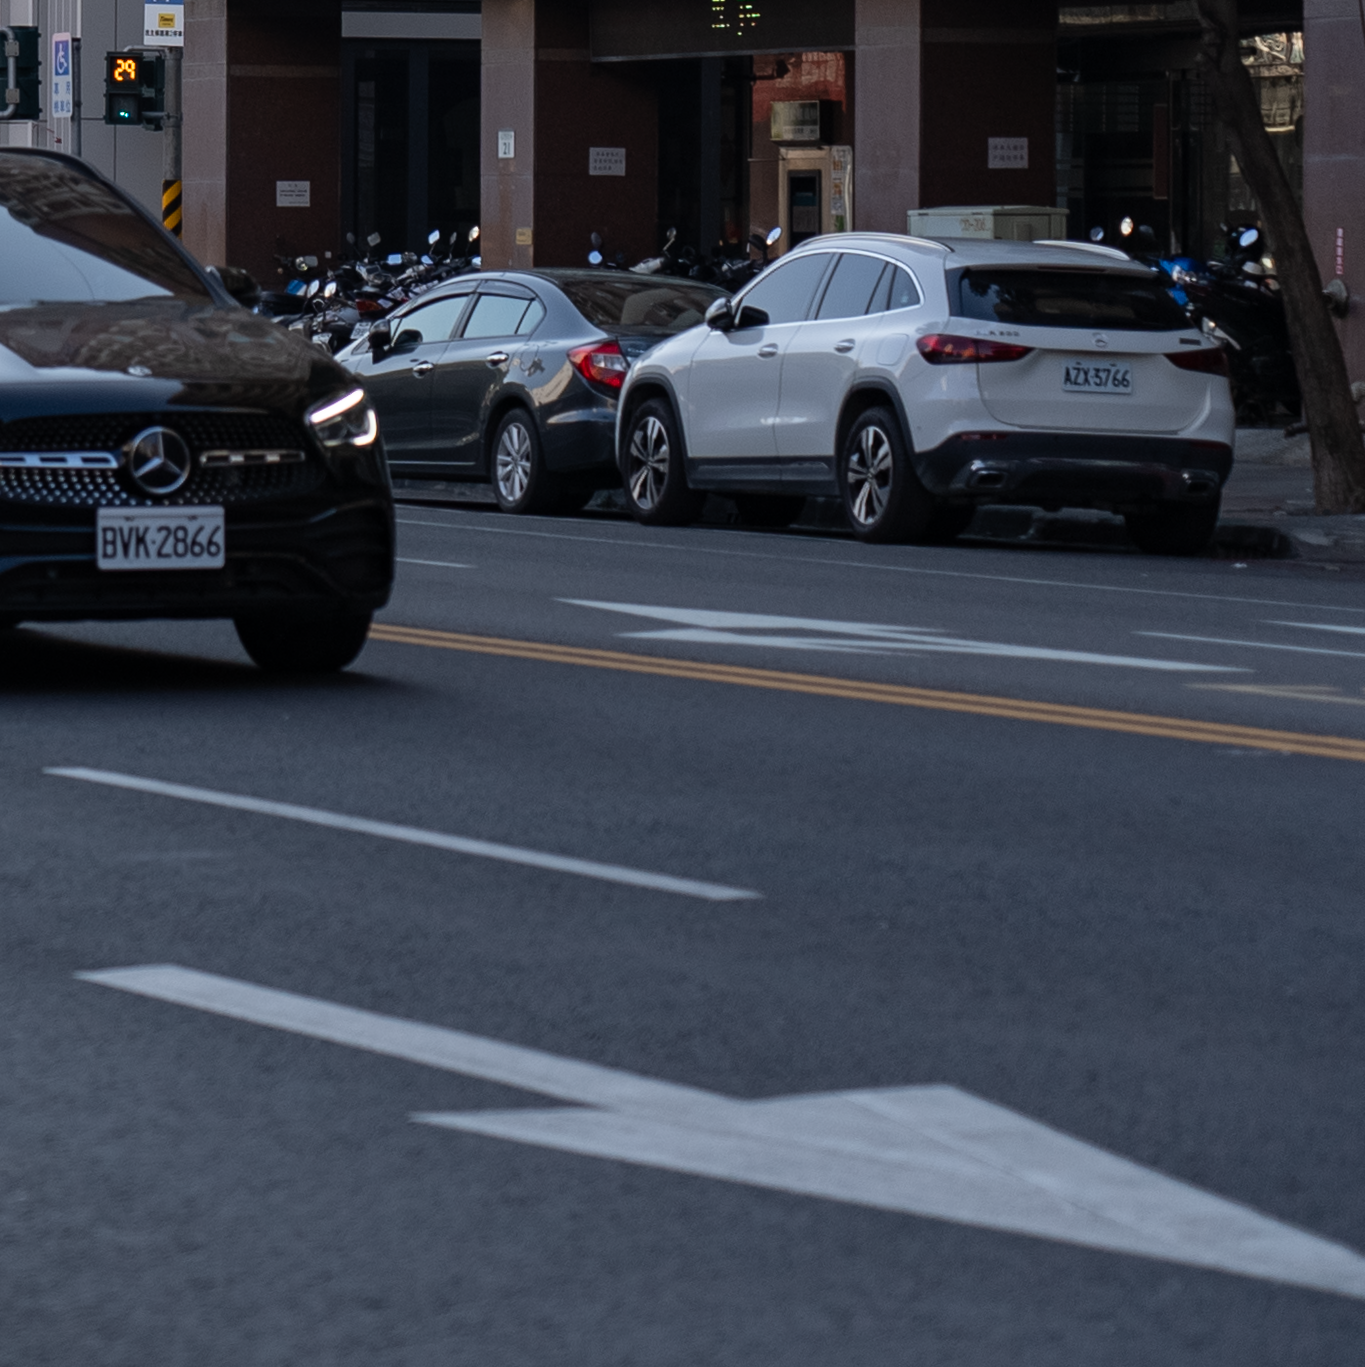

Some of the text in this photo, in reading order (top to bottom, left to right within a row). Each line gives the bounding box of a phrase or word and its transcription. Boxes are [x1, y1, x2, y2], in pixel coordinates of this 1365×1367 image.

[114, 59, 136, 81] 29
[1063, 367, 1130, 389] AZX-3766
[102, 525, 222, 559] BVK-2866
